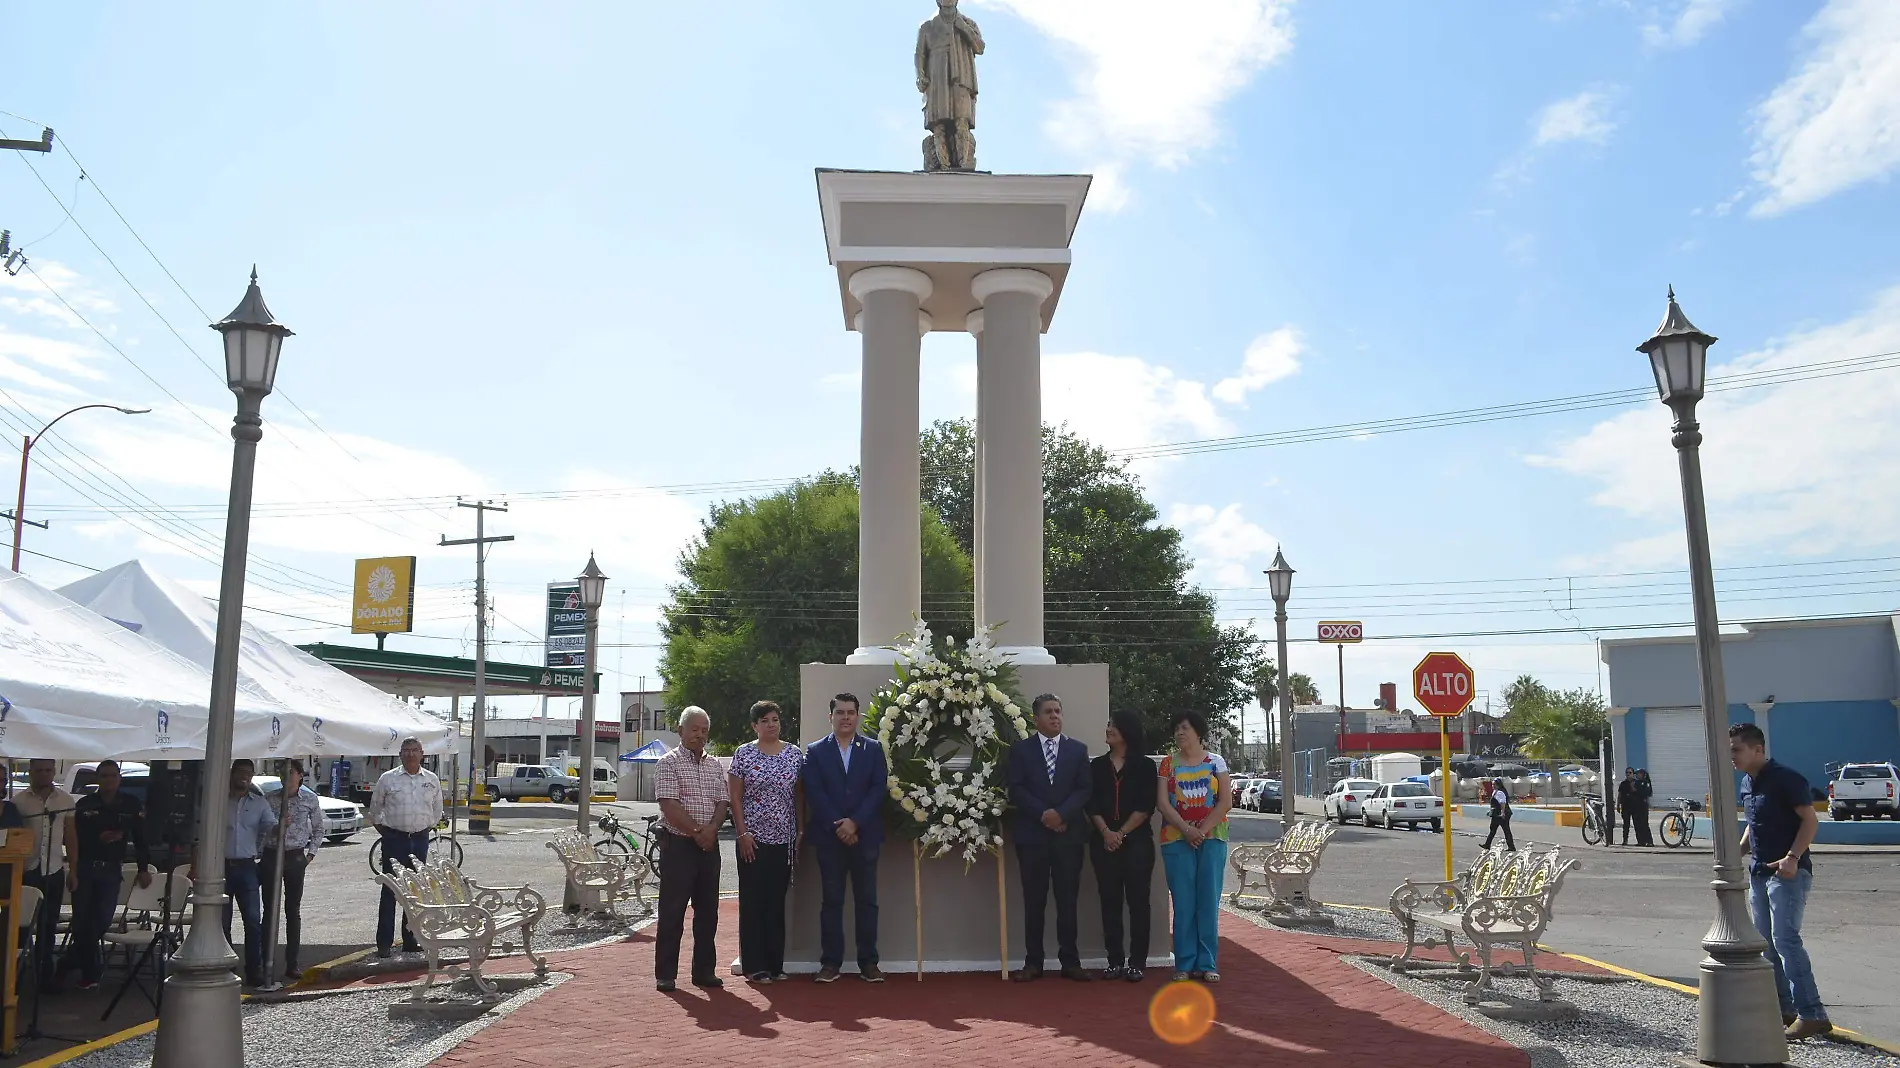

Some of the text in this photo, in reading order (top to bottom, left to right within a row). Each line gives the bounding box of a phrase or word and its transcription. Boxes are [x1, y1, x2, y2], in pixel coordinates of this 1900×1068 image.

[356, 606, 404, 619] DORADO
[554, 612, 587, 623] PEMEX
[1320, 625, 1361, 639] OXXO
[554, 673, 595, 687] PEME
[1419, 672, 1469, 696] ALTO
